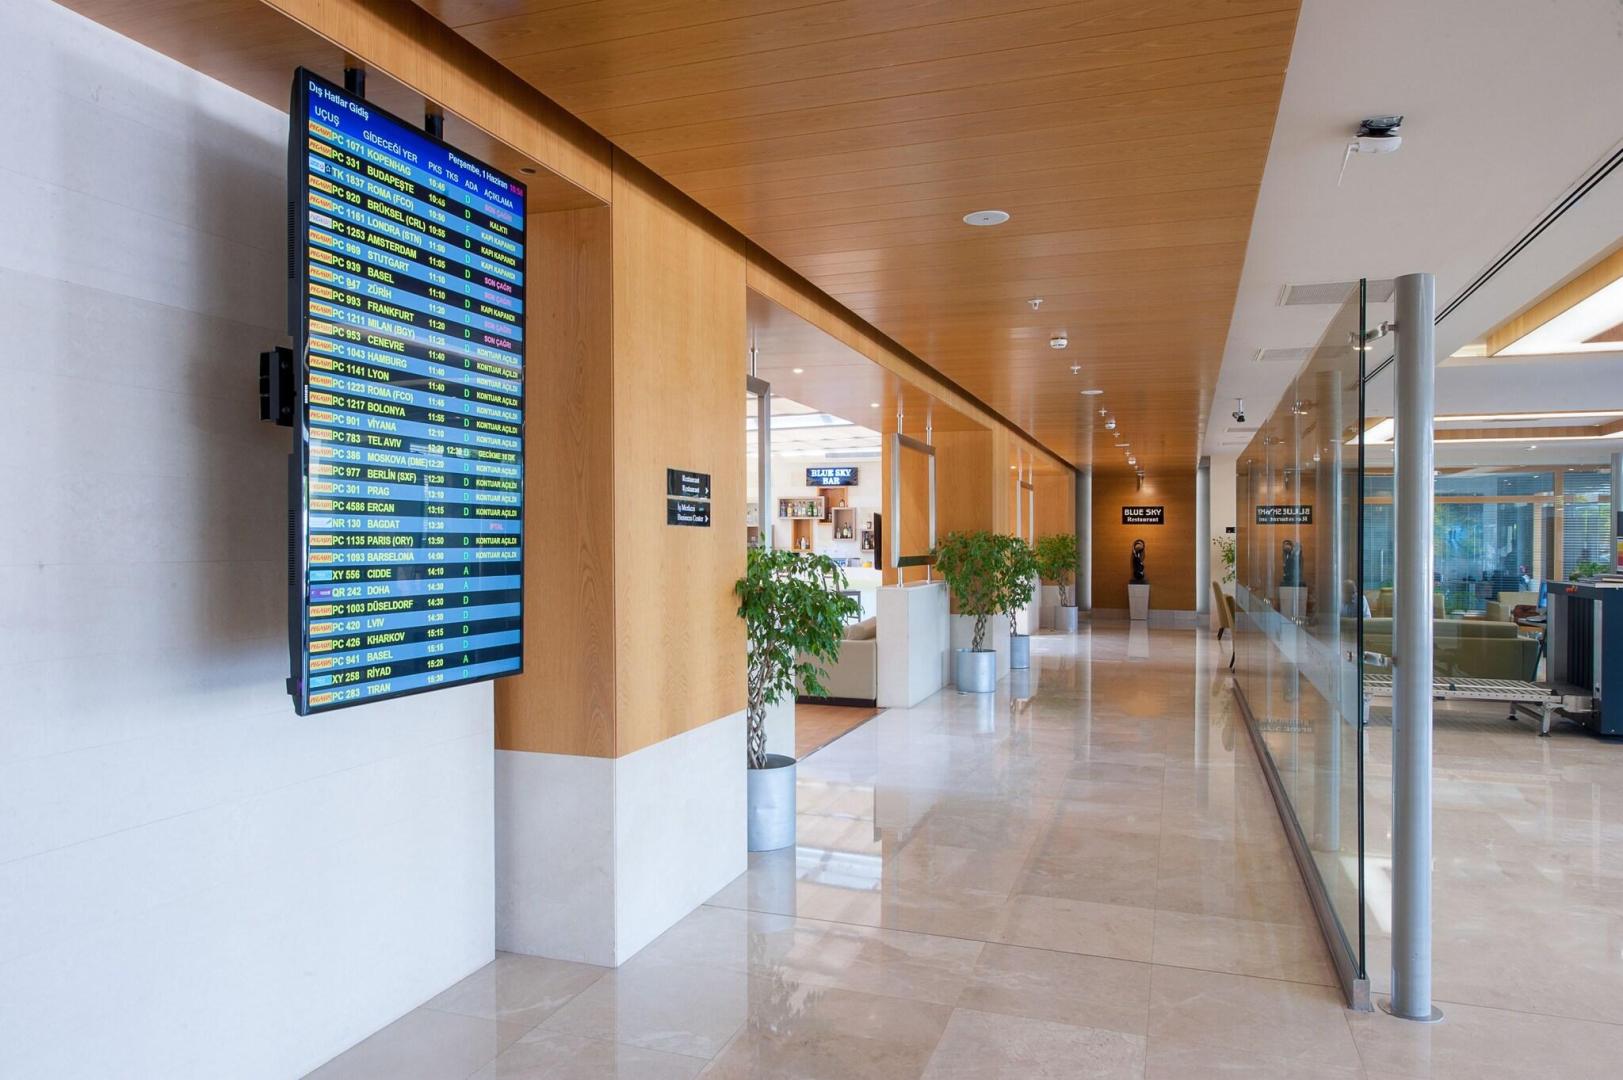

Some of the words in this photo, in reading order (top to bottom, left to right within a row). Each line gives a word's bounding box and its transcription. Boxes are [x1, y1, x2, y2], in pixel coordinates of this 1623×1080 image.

[324, 88, 347, 108] Hatlar
[349, 102, 369, 121] Gidiş
[315, 105, 340, 127] UÇUŞ
[402, 148, 418, 163] YER
[428, 161, 442, 175] PKS
[446, 169, 459, 183] TKS
[465, 179, 479, 192] ADA
[332, 132, 344, 146] PC
[346, 138, 365, 155] 1071
[367, 148, 412, 177] KOPENHAG
[332, 149, 344, 163] PC
[346, 155, 361, 170] 331
[367, 165, 414, 194] BUDAPEŞTE
[332, 167, 344, 180] TK
[367, 182, 391, 200] ROMA
[332, 185, 344, 198] PC
[346, 190, 360, 204] 920
[332, 202, 344, 215] PC
[367, 216, 401, 237] LONDRA
[332, 220, 344, 232] PC
[367, 232, 417, 259] AMSTERDAM
[332, 237, 344, 250] PC
[367, 249, 410, 272] STUTGART
[332, 255, 344, 267] PC
[346, 259, 360, 273] 939
[367, 266, 394, 283] BASEL
[332, 273, 344, 285] PC
[332, 290, 344, 302] PC
[346, 294, 360, 307] 993
[368, 300, 414, 322] FRANKFURT
[332, 308, 344, 320] PC
[332, 326, 344, 337] PC
[346, 329, 360, 341] 953
[367, 334, 404, 352] CENEVRE
[332, 343, 344, 354] PC
[368, 351, 407, 368] HAMBURG
[332, 361, 344, 372] PC
[346, 364, 365, 376] 1141
[368, 368, 389, 381] LYON
[332, 378, 344, 389] PC
[368, 385, 391, 397] ROMA
[332, 396, 344, 406] PC
[346, 398, 365, 410] 1217
[368, 402, 405, 416] BOLONYA
[332, 413, 344, 424] PC
[332, 431, 344, 441] PC
[346, 433, 360, 443] 783
[367, 435, 383, 445] TEL
[332, 448, 344, 458] PC
[332, 466, 344, 475] PC
[345, 467, 360, 477] 977
[811, 469, 834, 477] BLUE
[835, 469, 851, 477] SKY
[822, 477, 840, 485] BAR
[332, 483, 344, 493] PC
[367, 486, 390, 495] PRAG
[332, 501, 344, 510] PC
[367, 502, 394, 512] ERCAN
[1124, 508, 1144, 516] BLUE
[1145, 508, 1162, 516] SKY
[332, 518, 344, 527] NR
[345, 519, 360, 527] 130
[367, 519, 400, 528] BAGDAT
[332, 536, 344, 544] PC
[345, 536, 365, 544] 1135
[367, 536, 391, 544] PARIS
[332, 553, 344, 562] PC
[367, 552, 414, 561] BARSELONA
[332, 570, 344, 579] XY
[345, 570, 360, 578] 556
[367, 569, 392, 578] CIDDE
[332, 587, 344, 596] QR
[345, 586, 360, 596] 242
[367, 585, 390, 594] DOHA
[332, 604, 344, 614] PC
[345, 603, 365, 613] 1003
[332, 622, 344, 631] PC
[367, 618, 384, 628] LVIV
[332, 639, 344, 649] PC
[345, 637, 360, 647] 426
[367, 632, 405, 644] KHARKOV
[332, 656, 344, 666] PC
[367, 649, 393, 661] BASEL
[332, 673, 344, 683] XY
[345, 671, 360, 681] 258
[332, 690, 344, 701] PC
